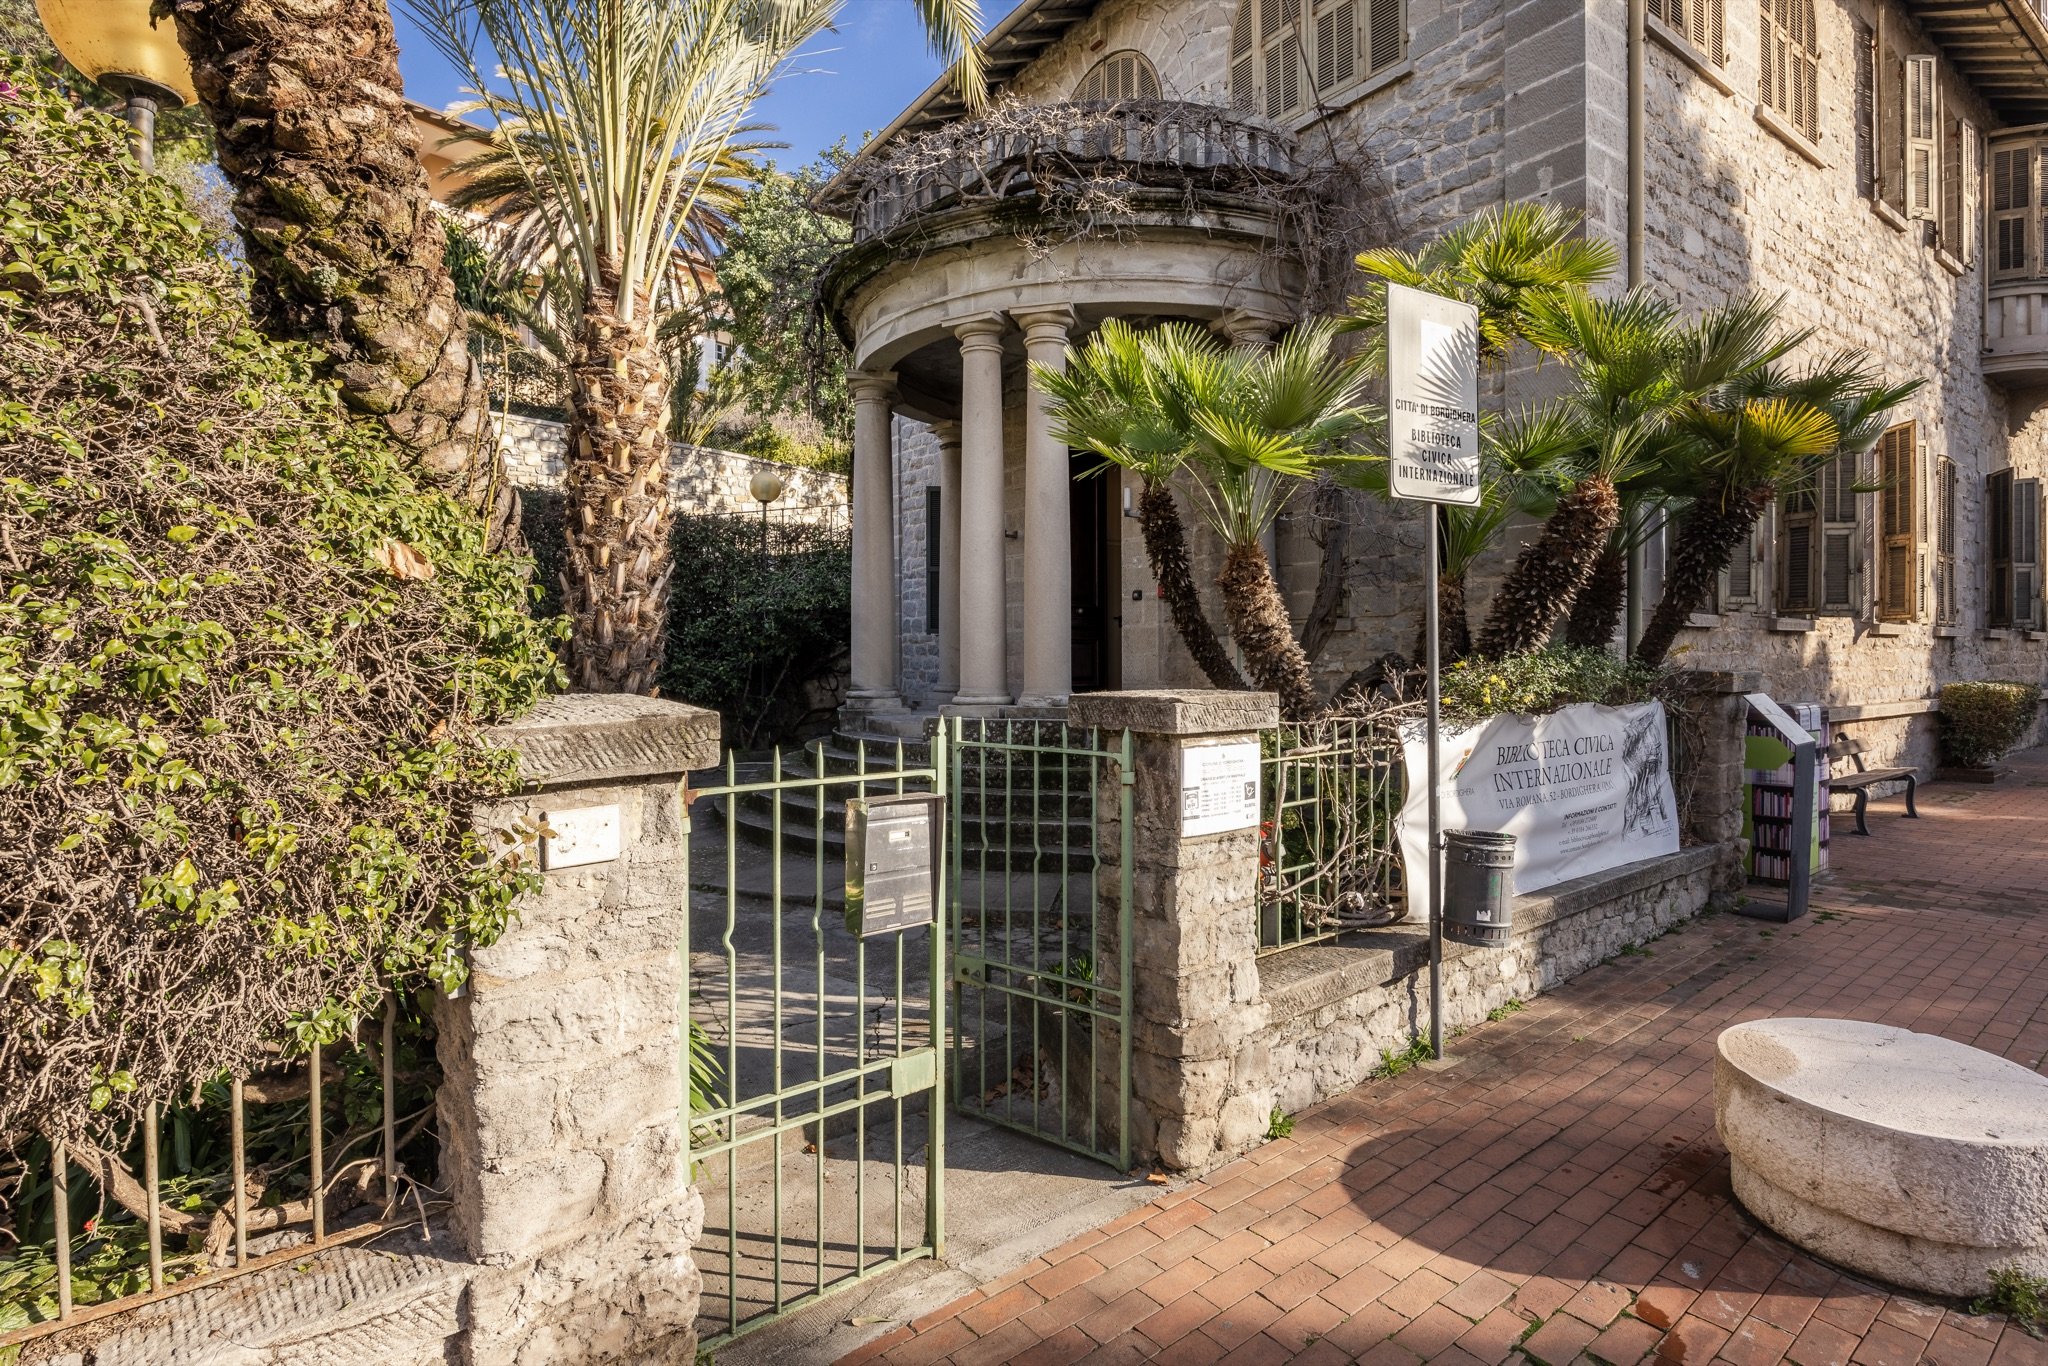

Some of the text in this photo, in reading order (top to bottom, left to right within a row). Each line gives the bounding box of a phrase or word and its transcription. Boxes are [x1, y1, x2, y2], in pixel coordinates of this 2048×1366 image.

[1420, 403, 1428, 415] DI
[1430, 405, 1476, 424] BORDIGHERA
[1411, 428, 1462, 449] BIBLIOTECA
[1421, 449, 1452, 465] CIVICA
[1398, 464, 1474, 487] INTERNAZIONALE
[1496, 734, 1614, 766] BIBLIOTECA CIVICA
[1493, 757, 1613, 793] INTERNAZIONALE
[1498, 799, 1515, 810] VIA
[1560, 783, 1601, 800] BORDIGHERA
